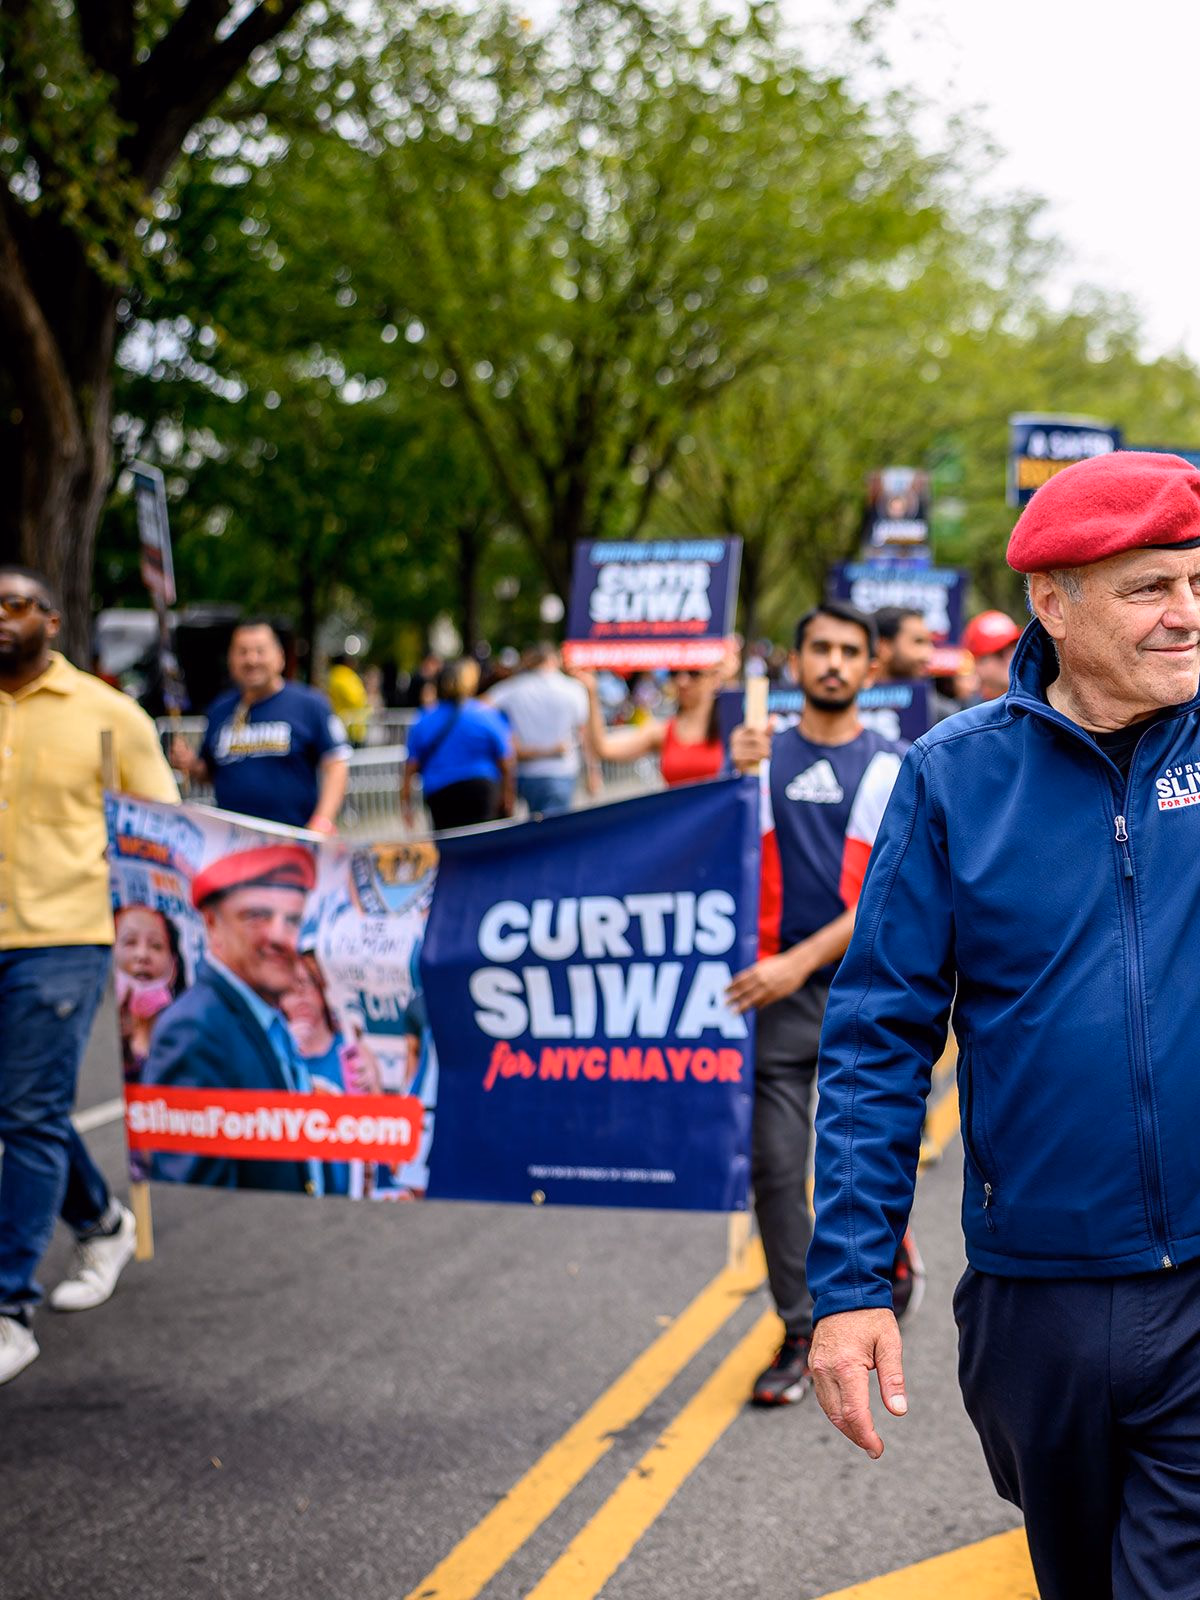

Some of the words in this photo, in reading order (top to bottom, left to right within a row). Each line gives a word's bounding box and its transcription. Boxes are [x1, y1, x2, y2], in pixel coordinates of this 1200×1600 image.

[1161, 799, 1181, 809] FOR
[478, 889, 737, 963] CURTIS
[468, 960, 749, 1040] SLIWA
[482, 1039, 537, 1093] for
[538, 1046, 608, 1081] NYC
[608, 1046, 743, 1083] MAYOR
[127, 1097, 412, 1147] SliwaForNYC.com
